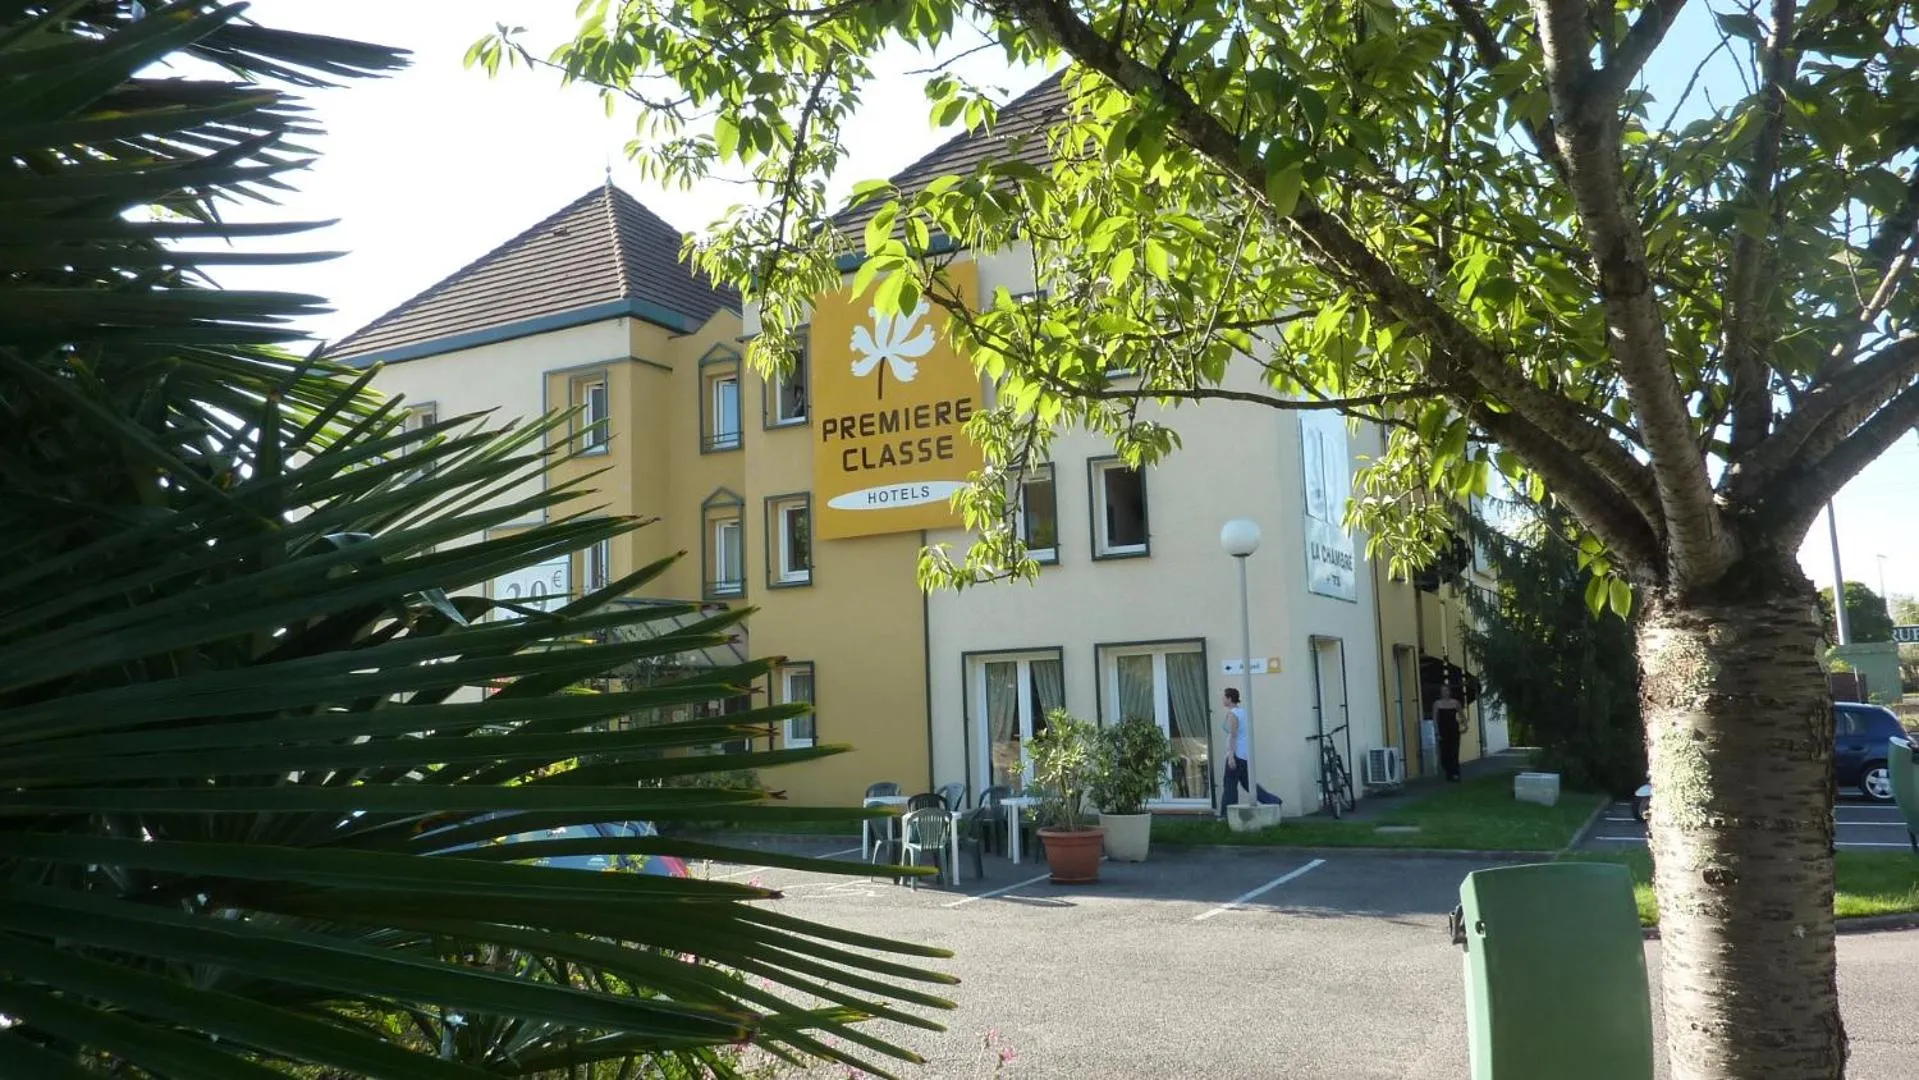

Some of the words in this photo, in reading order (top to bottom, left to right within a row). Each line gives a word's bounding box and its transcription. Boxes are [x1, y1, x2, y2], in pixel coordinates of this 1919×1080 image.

[823, 398, 972, 442] PREMIERE
[843, 435, 953, 472] CLASSE
[868, 486, 930, 504] HOTELS
